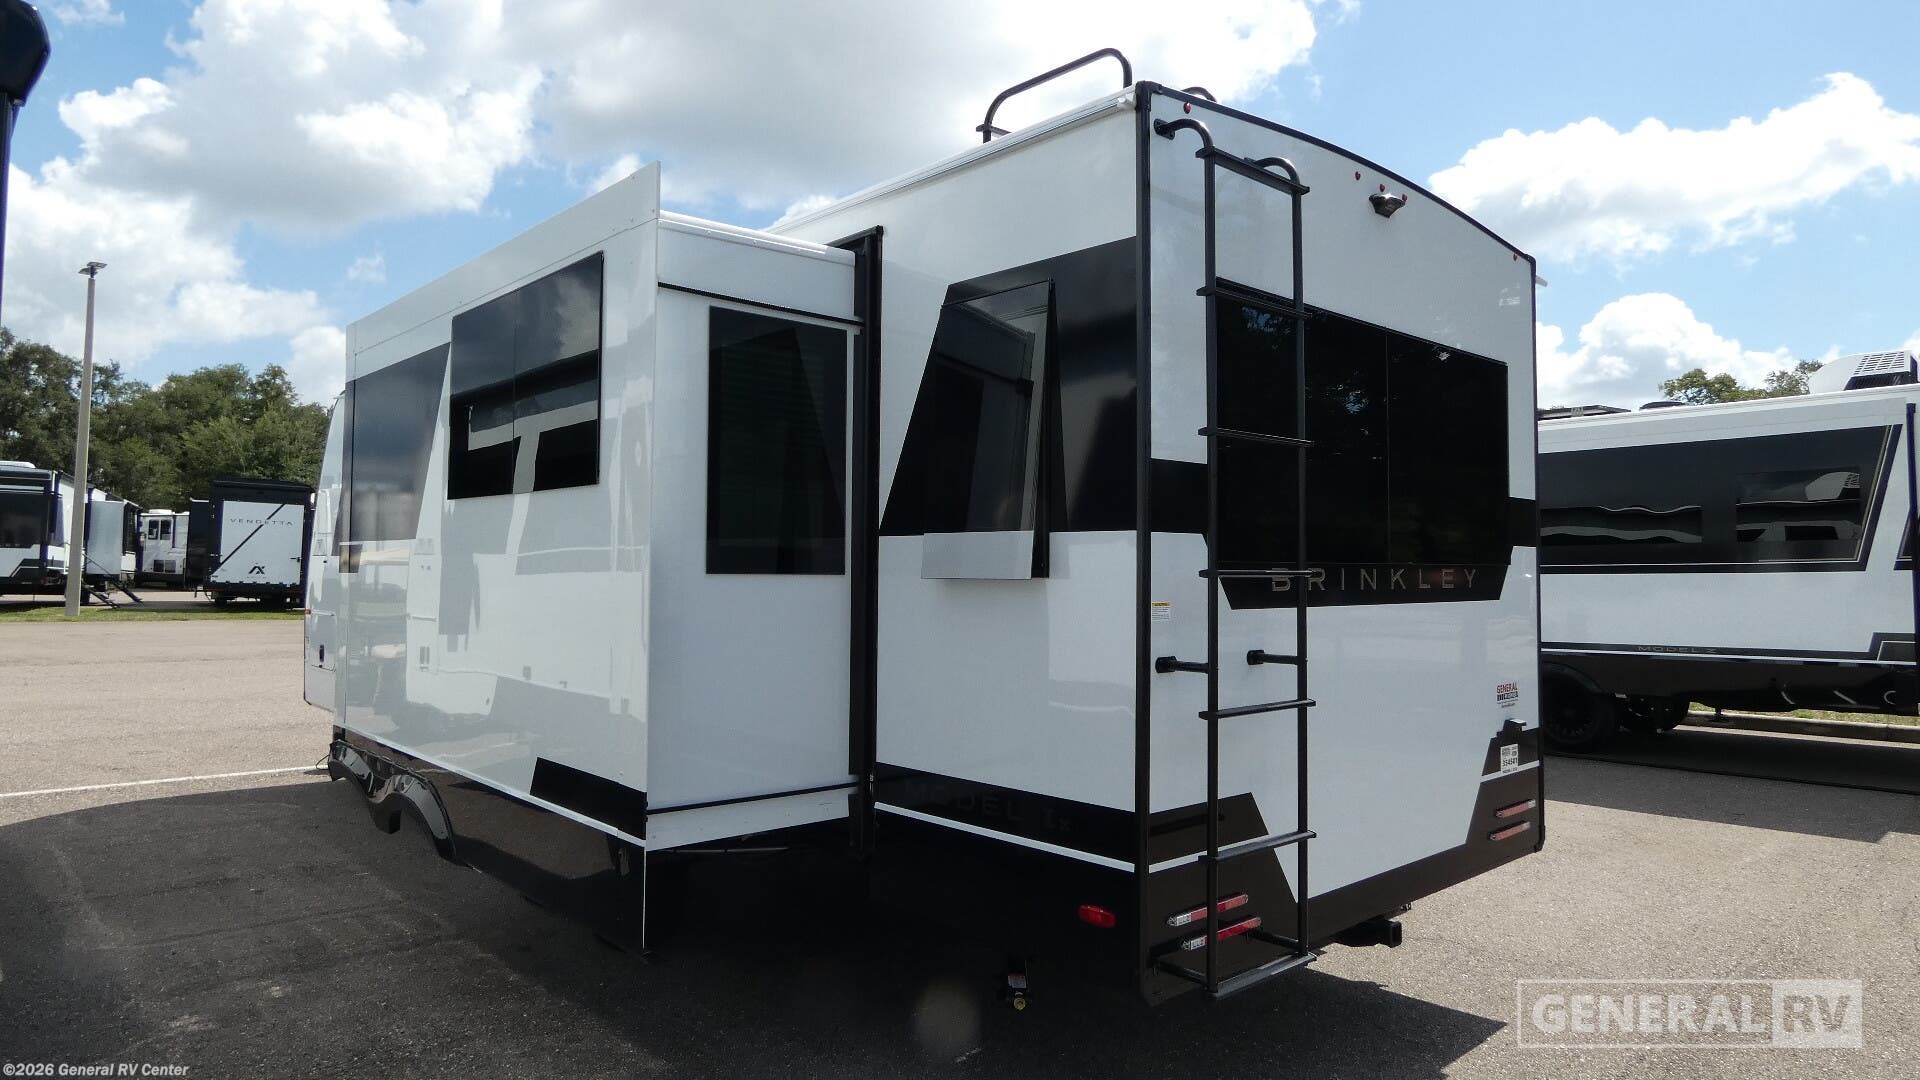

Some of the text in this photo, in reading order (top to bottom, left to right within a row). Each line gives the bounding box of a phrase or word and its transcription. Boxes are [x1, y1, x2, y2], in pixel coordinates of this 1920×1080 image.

[230, 518, 293, 526] VENDETTA
[1271, 567, 1477, 592] BRINKLEY
[1637, 645, 1700, 653] MODEL
